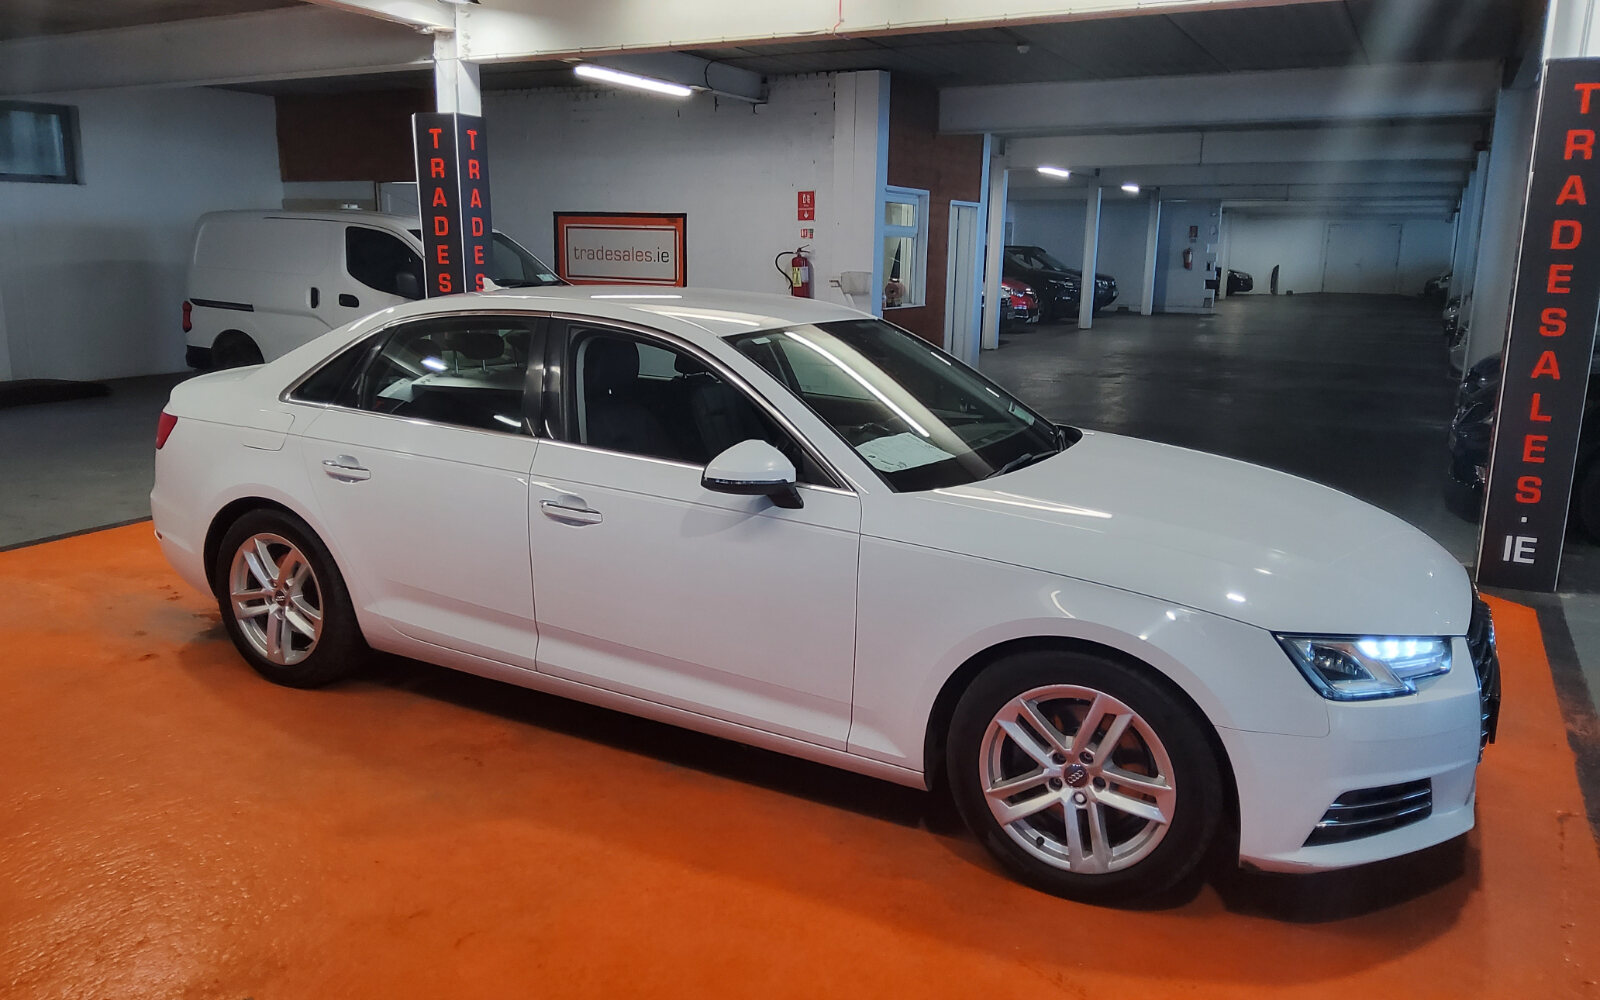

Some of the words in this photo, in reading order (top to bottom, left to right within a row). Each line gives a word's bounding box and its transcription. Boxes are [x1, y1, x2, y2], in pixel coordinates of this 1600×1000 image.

[429, 128, 452, 292] TRADES
[466, 129, 486, 292] TRADES
[574, 246, 670, 263] tradesales.ie
